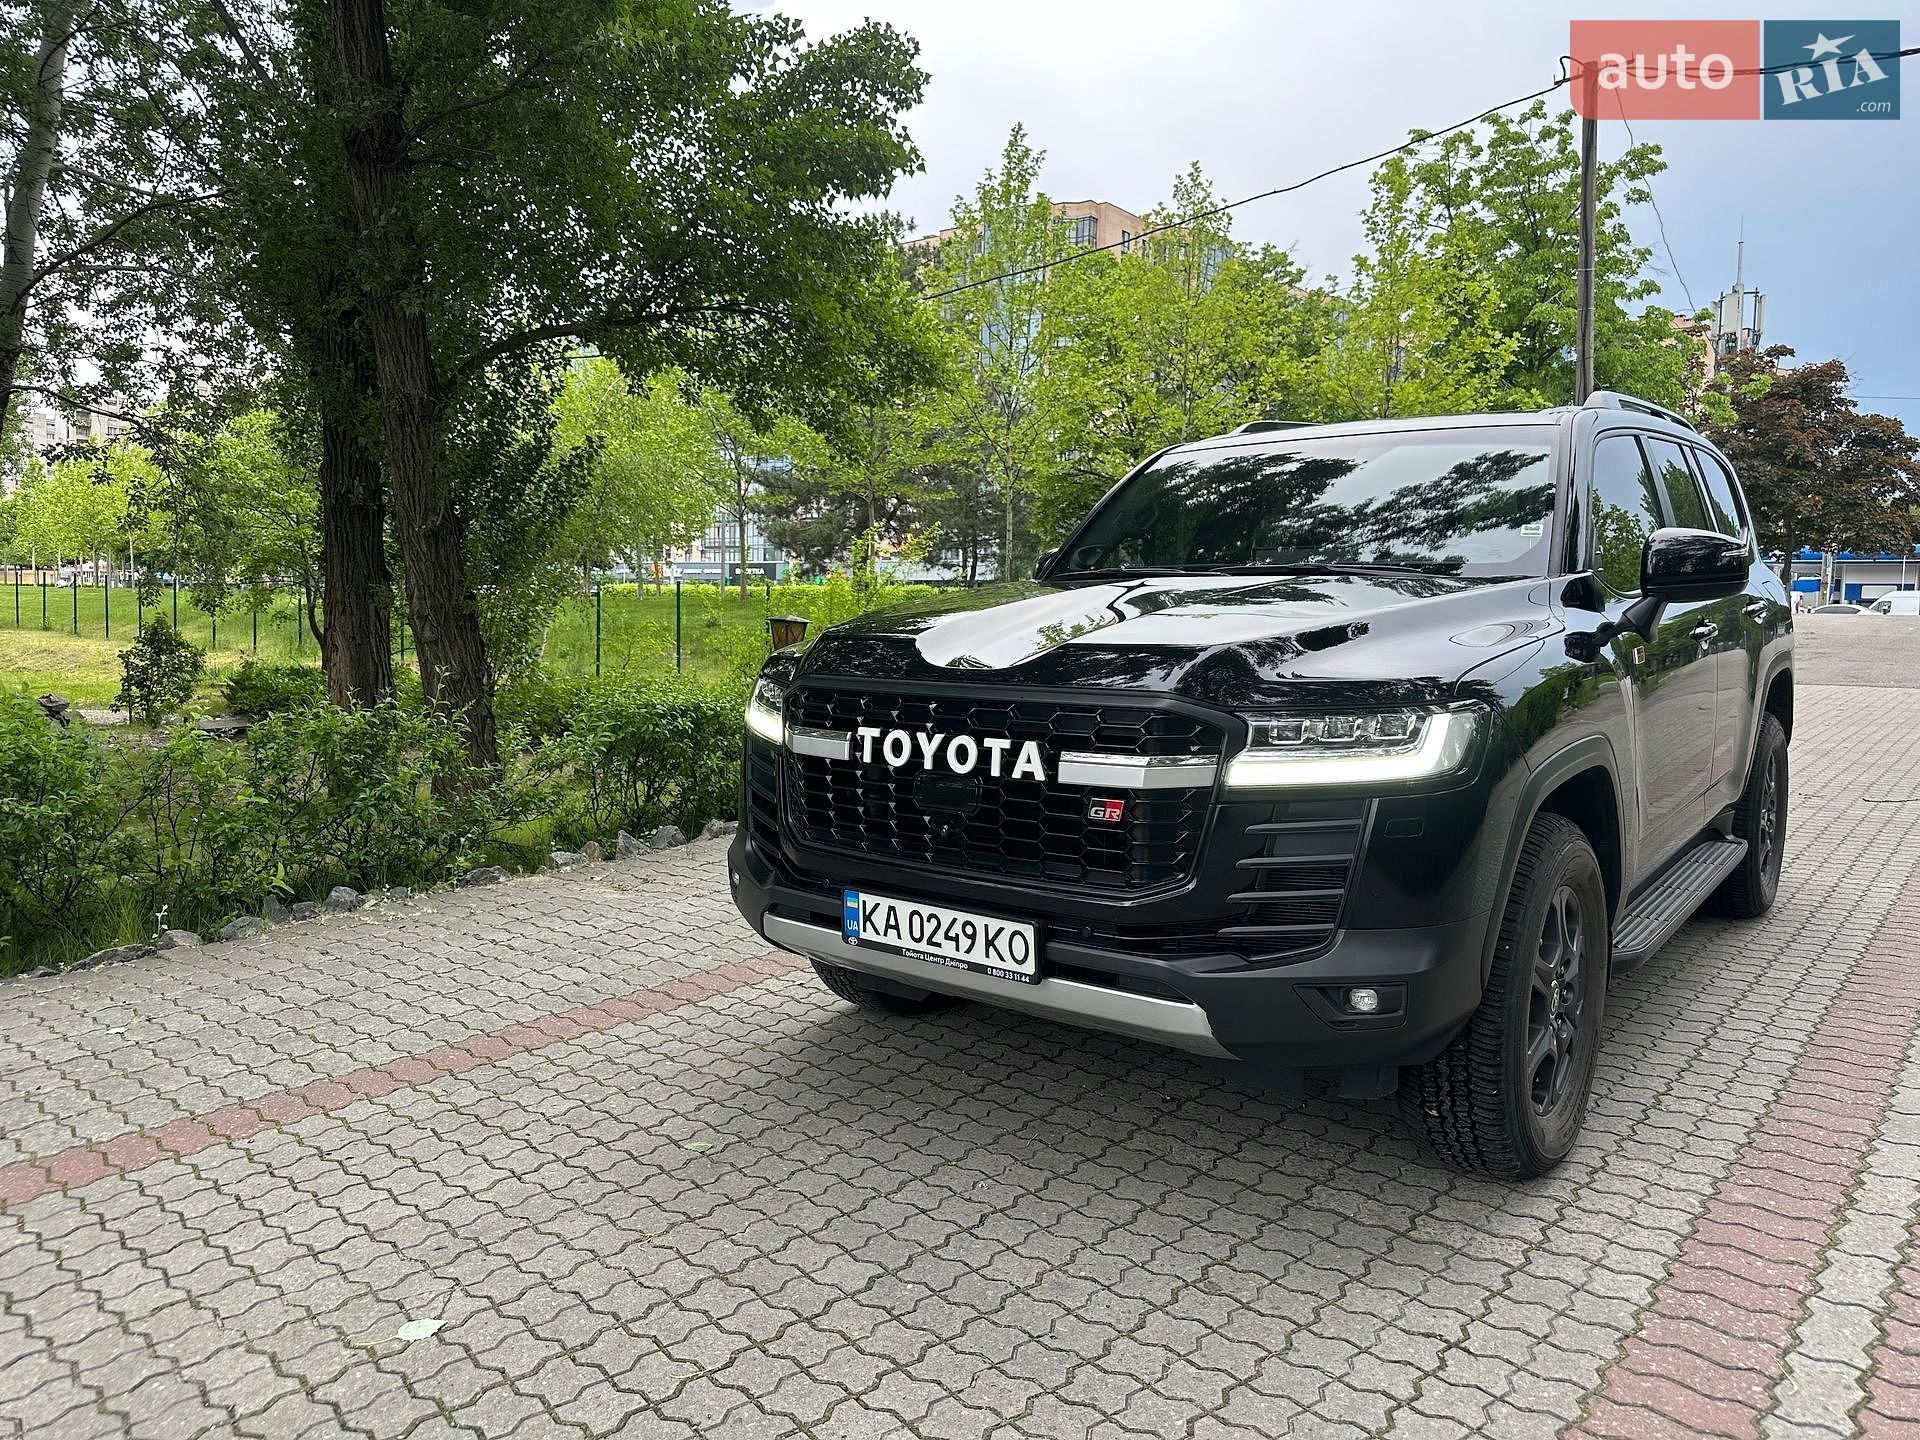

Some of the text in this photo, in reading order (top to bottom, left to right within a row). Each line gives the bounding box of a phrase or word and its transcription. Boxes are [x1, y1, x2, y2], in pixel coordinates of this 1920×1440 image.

[857, 726, 1047, 782] TOYOTA
[1090, 806, 1121, 820] GR
[847, 919, 859, 932] UA
[908, 909, 978, 955] 0249
[902, 948, 969, 970] Тойота Центр Дніпро
[987, 967, 1030, 983] 0 800 33 11 44
